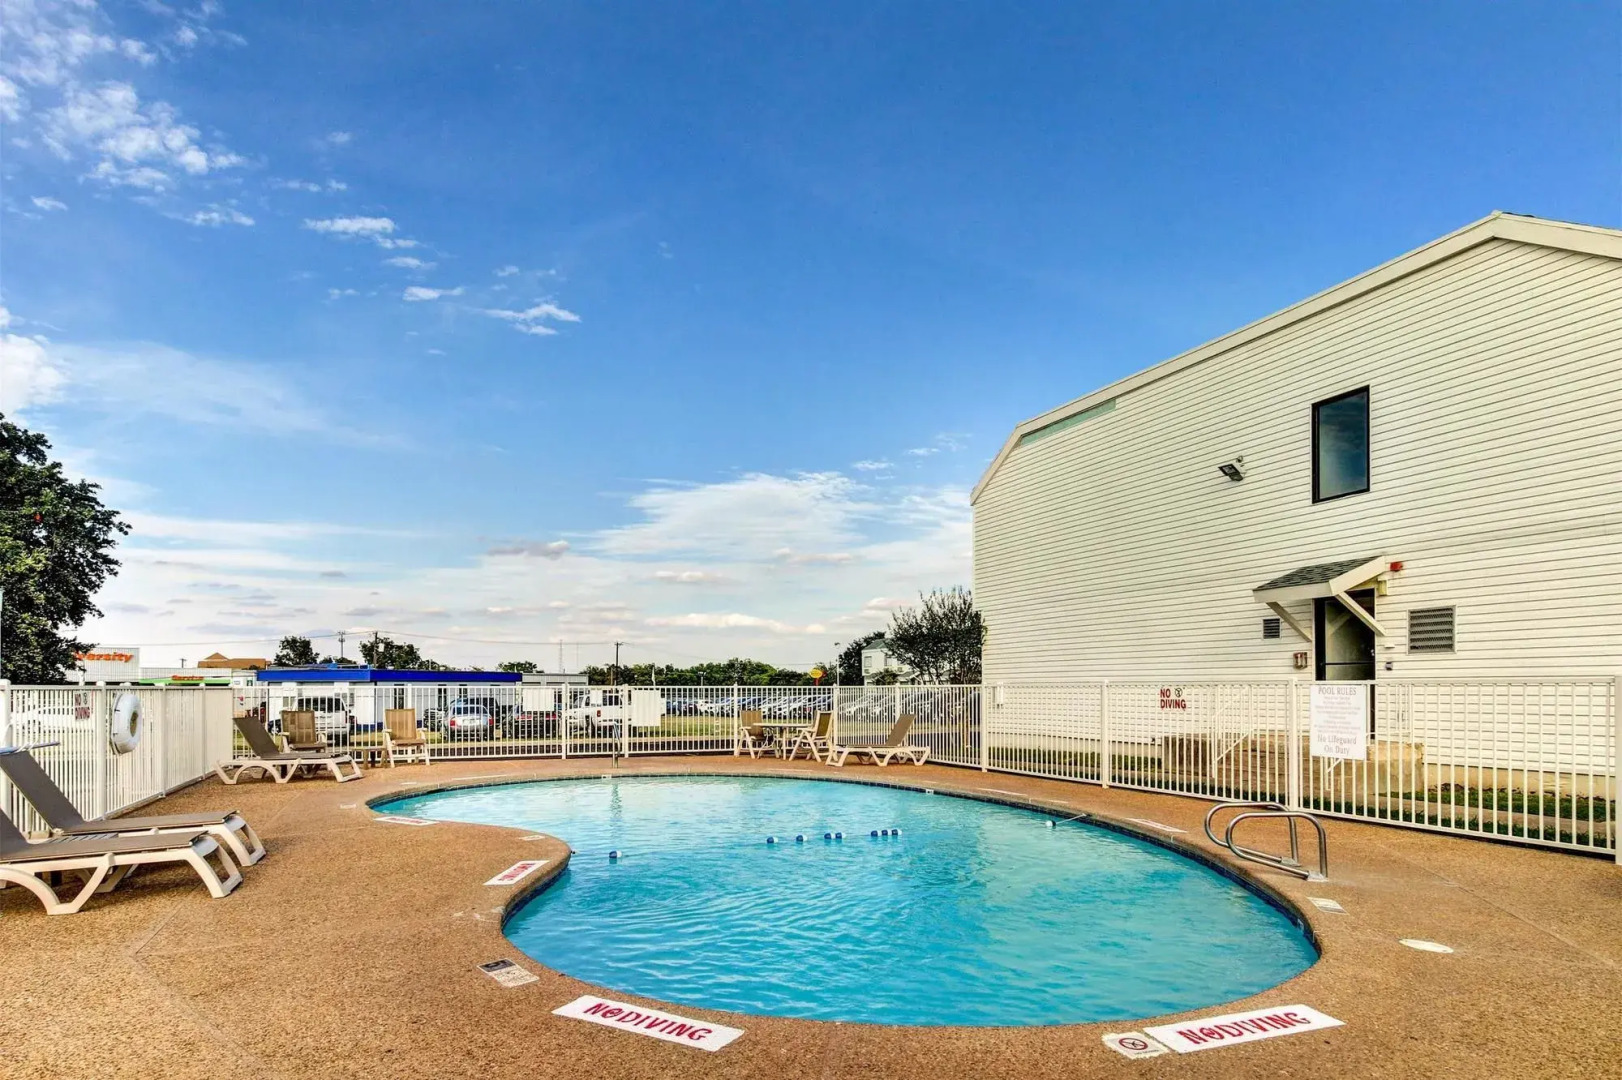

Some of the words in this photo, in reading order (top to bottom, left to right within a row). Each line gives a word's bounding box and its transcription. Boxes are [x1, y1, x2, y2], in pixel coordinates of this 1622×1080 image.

[1160, 688, 1171, 698] NO
[1318, 686, 1335, 695] POOL
[1337, 687, 1357, 696] RULES
[1160, 699, 1187, 709] DIVING
[1317, 734, 1327, 743] No
[1328, 735, 1357, 745] Lifeguard
[1335, 746, 1350, 755] Duty
